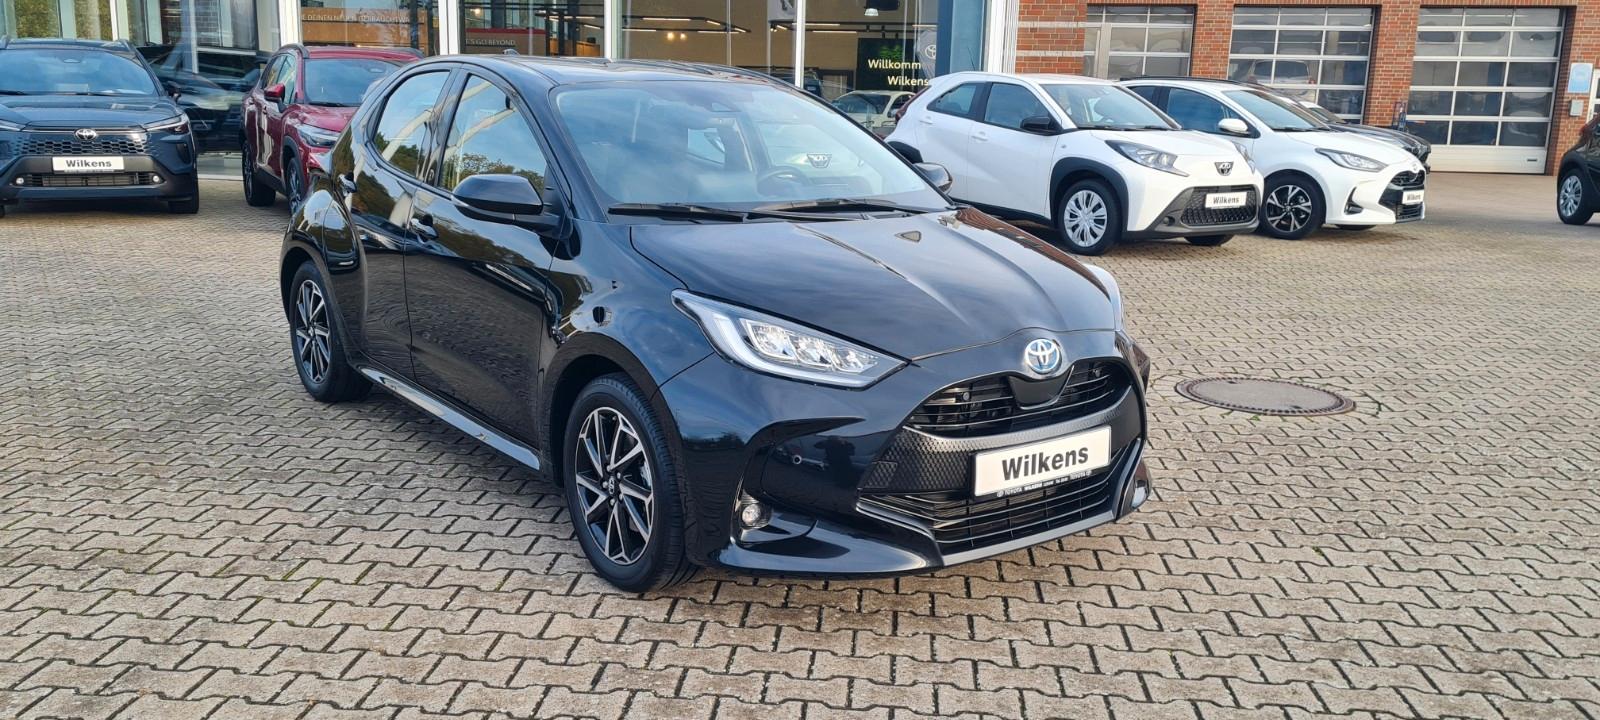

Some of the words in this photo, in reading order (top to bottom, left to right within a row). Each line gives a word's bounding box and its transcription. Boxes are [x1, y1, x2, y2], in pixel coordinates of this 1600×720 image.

[867, 59, 921, 69] Willkomm
[887, 75, 929, 86] Wilkens
[65, 159, 112, 168] Wilkens
[1213, 196, 1240, 204] Wilkens
[1001, 447, 1089, 481] Wilkens
